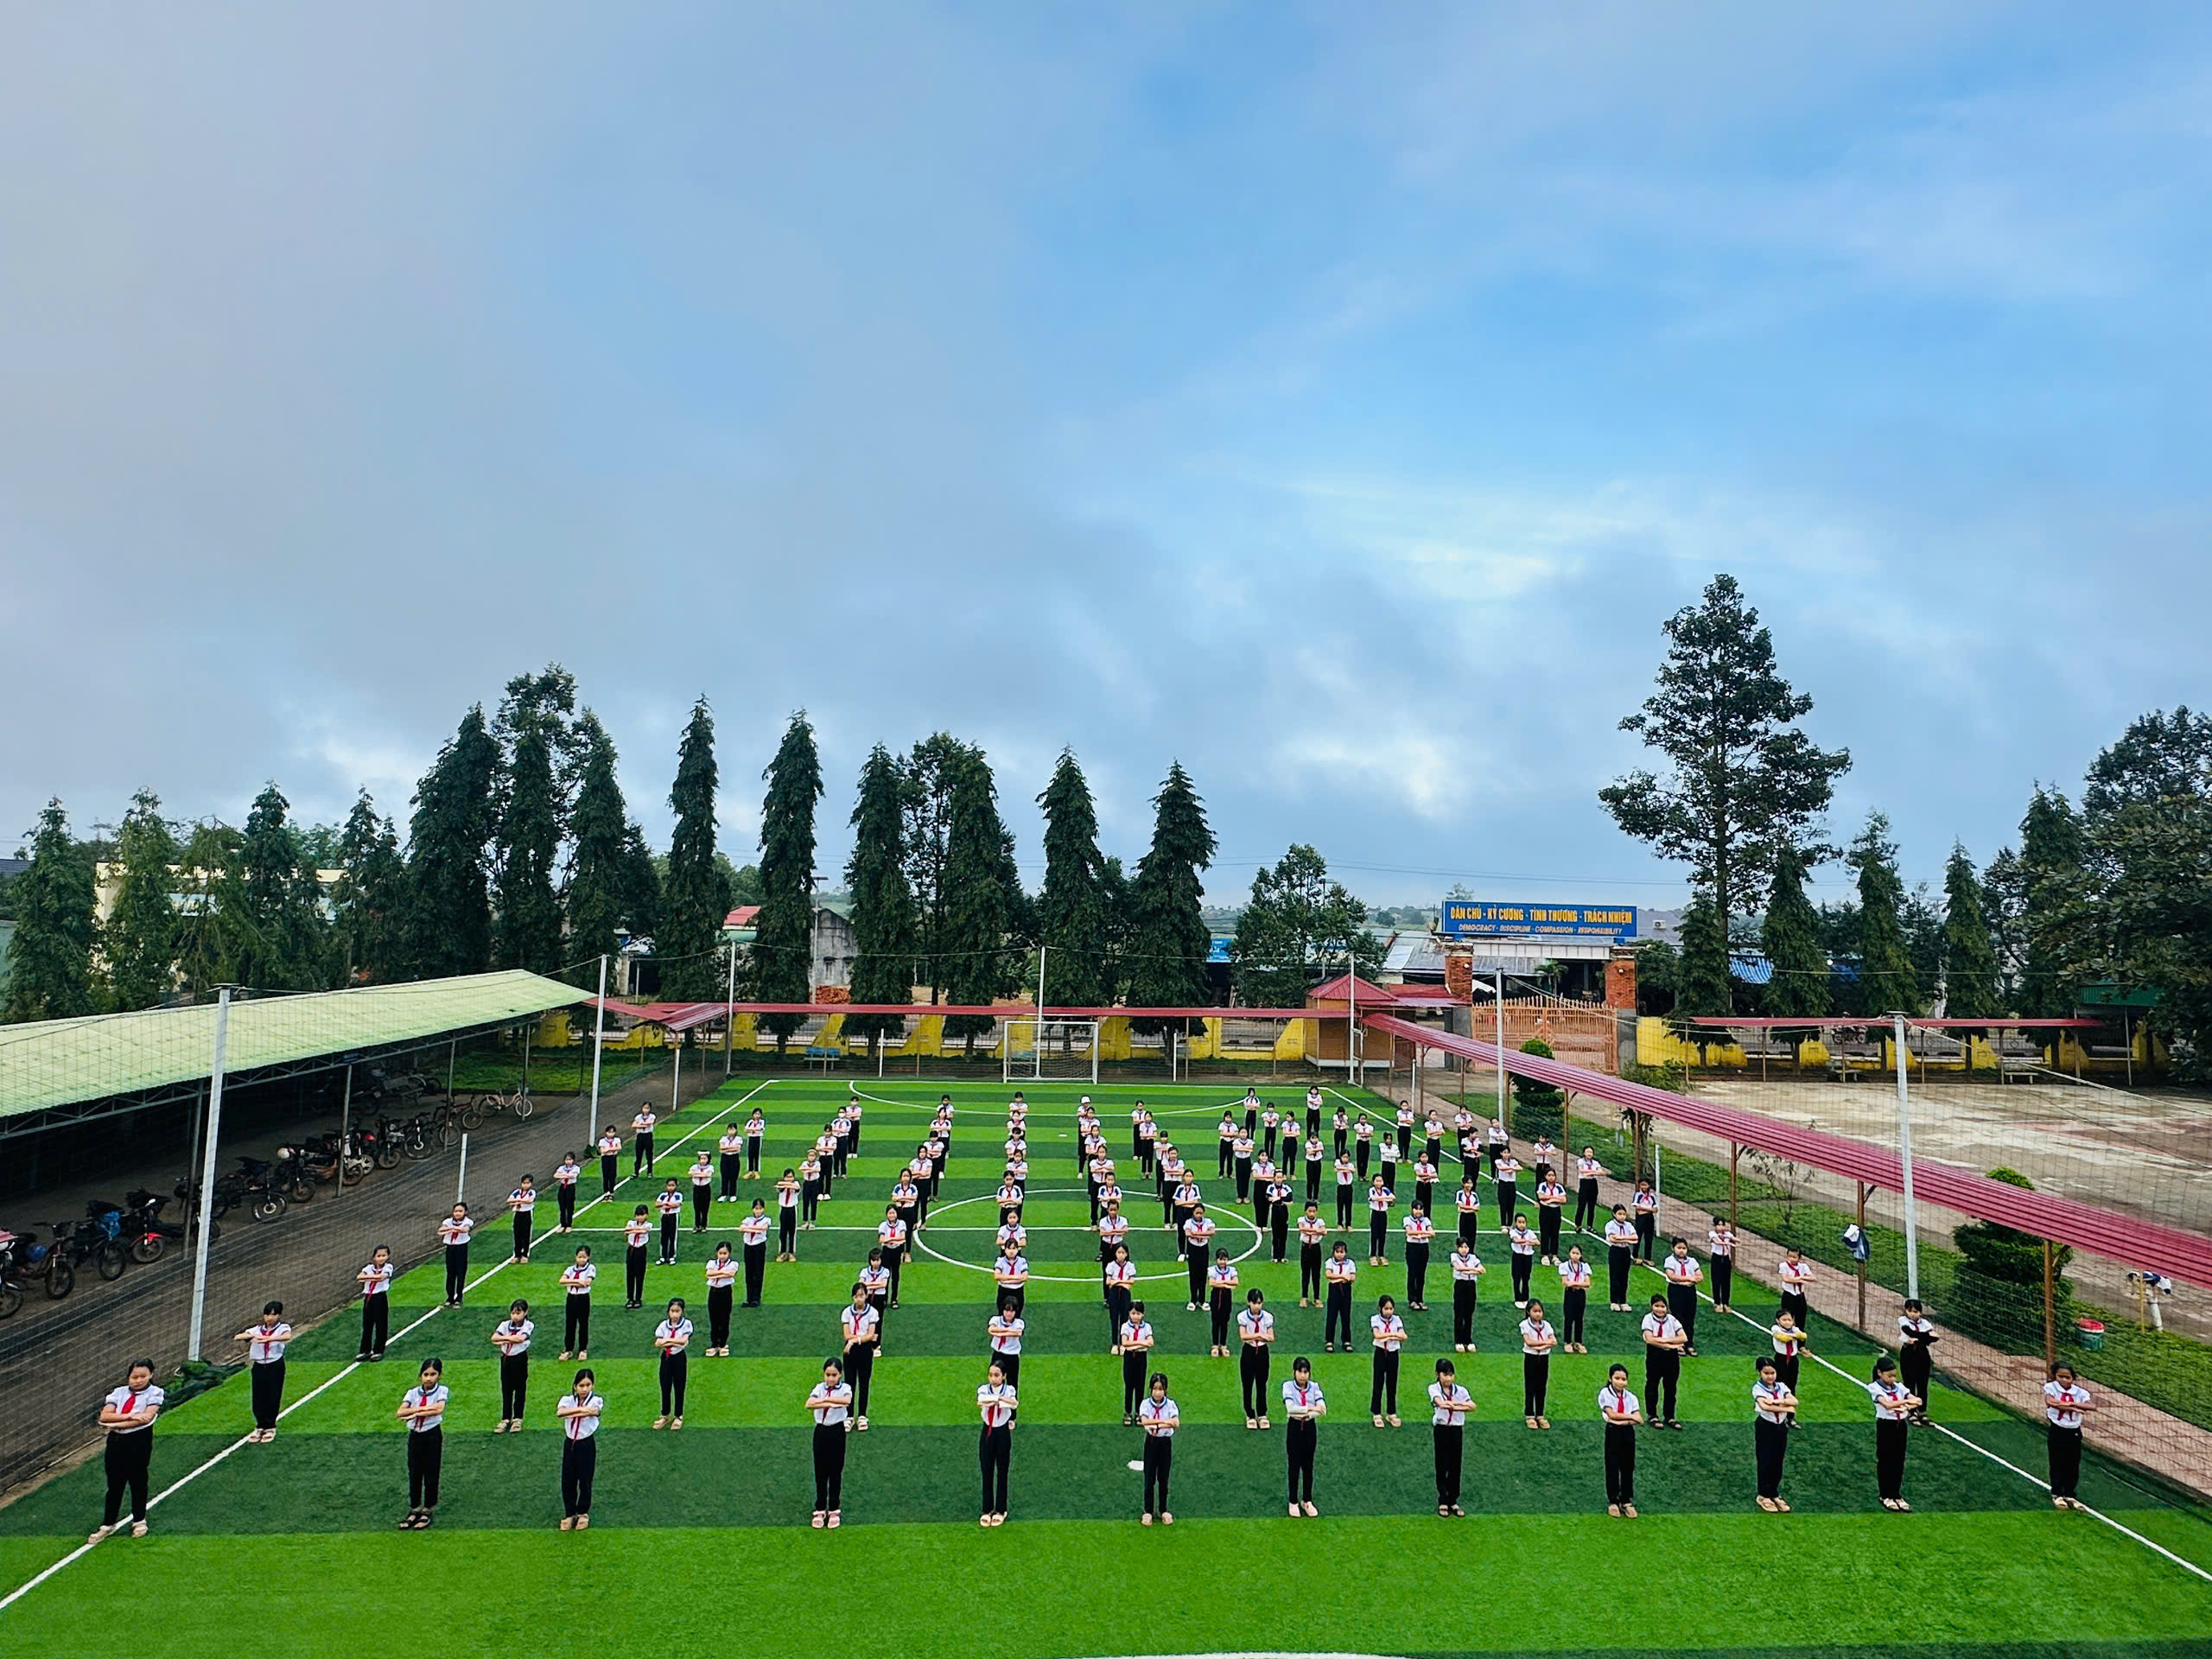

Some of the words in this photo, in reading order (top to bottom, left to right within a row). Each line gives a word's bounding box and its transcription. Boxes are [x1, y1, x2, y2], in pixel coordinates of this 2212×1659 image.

[1451, 905, 1465, 919] DÂN
[1529, 906, 1547, 922] TÌNH
[1583, 908, 1607, 923] TRÁCH
